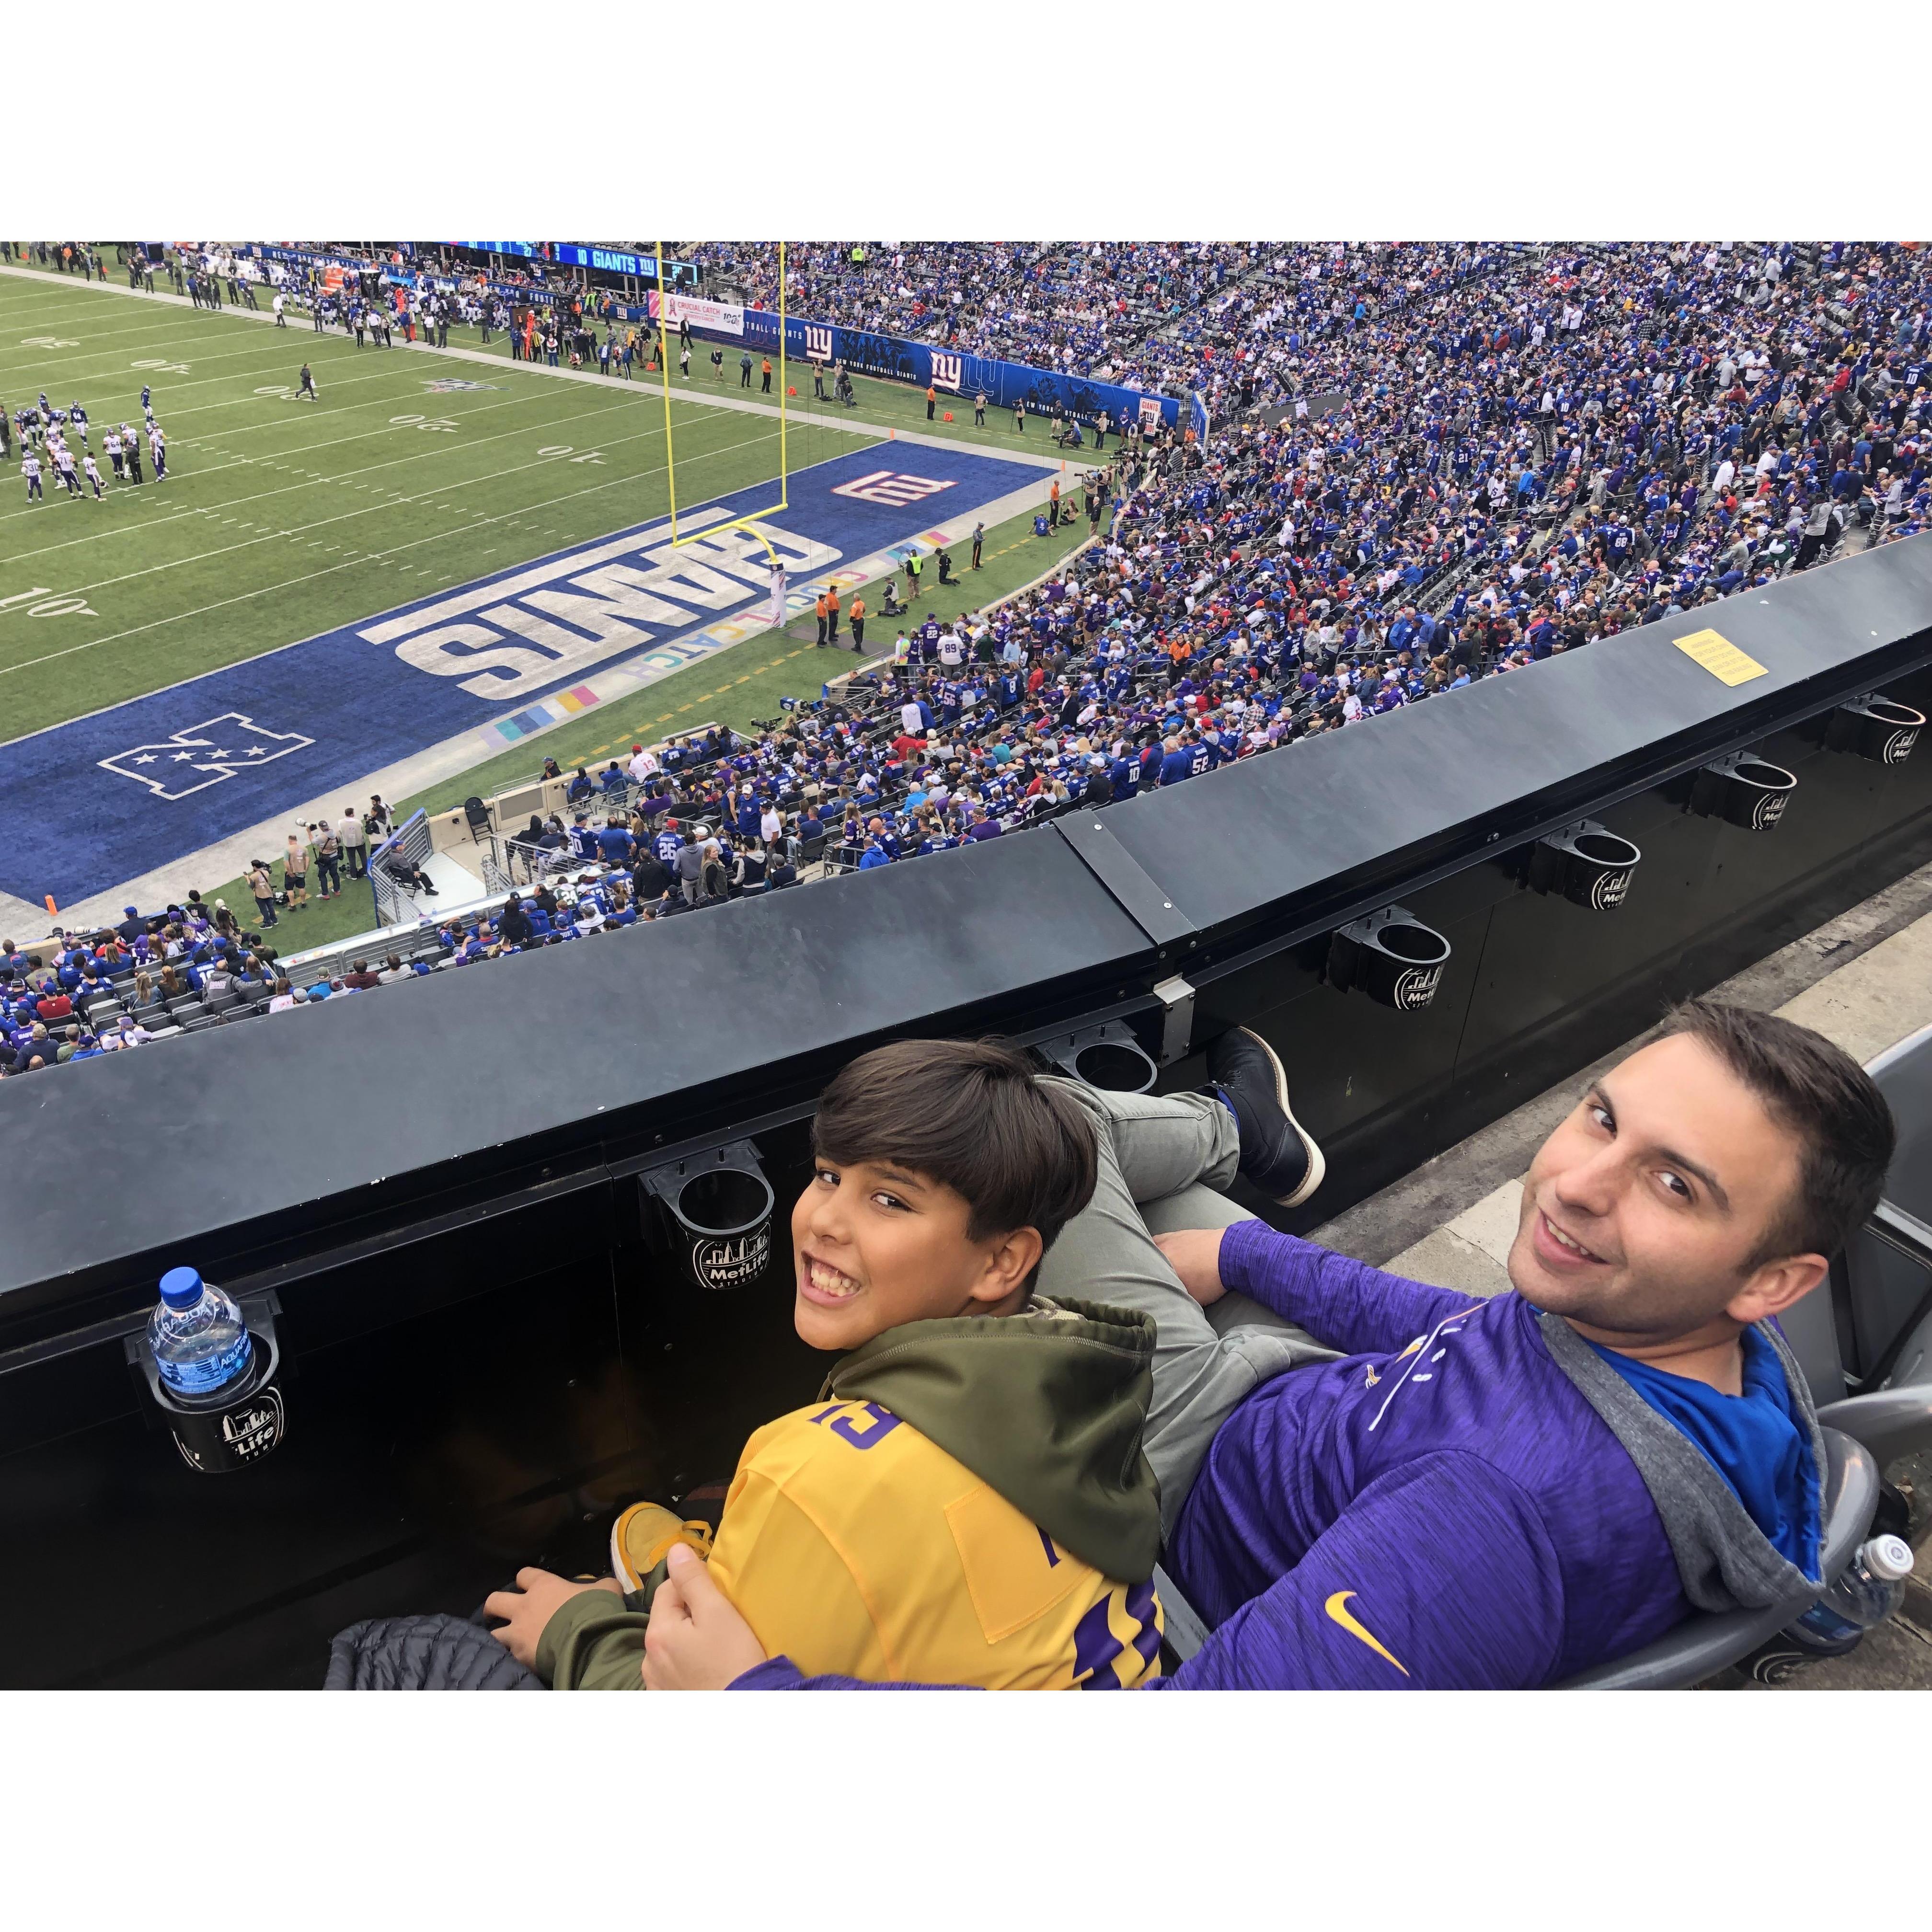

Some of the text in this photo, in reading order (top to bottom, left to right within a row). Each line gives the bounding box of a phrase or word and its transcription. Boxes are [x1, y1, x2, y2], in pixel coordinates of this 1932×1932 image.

[577, 248, 587, 265] 10
[592, 250, 636, 274] GIANTS
[678, 301, 721, 316] CRUCIAL CATCH
[743, 321, 769, 334] TBALL
[805, 325, 832, 361] ny
[849, 360, 864, 368] YORK
[866, 364, 894, 376] FOOTBALL
[896, 370, 917, 380] GIANTS
[931, 351, 962, 391] ny
[1906, 372, 1919, 385] 10
[1141, 400, 1159, 412] GIANTS
[1560, 402, 1569, 413] 10
[1065, 409, 1089, 421] OTBALL
[388, 414, 461, 433] 20
[1145, 423, 1155, 434] RIDE
[537, 445, 608, 464] 10
[1458, 452, 1468, 463] 21
[28, 463, 39, 472] 30
[1232, 523, 1243, 534] 30
[1614, 537, 1628, 548] 88
[391, 514, 844, 701] GIANTS
[926, 629, 938, 639] 22
[621, 625, 747, 680] CATCH
[945, 644, 956, 654] 89
[1702, 646, 1718, 655] YOUR
[1702, 654, 1720, 664] SAFETY
[1712, 662, 1725, 671] LEAN
[1735, 663, 1753, 673] RAILING
[1009, 680, 1016, 694] 8
[943, 692, 956, 706] 56
[1128, 766, 1140, 783] 10
[658, 842, 677, 860] 26
[561, 890, 579, 905] 24
[208, 980, 227, 989] GIANTS
[710, 1250, 768, 1280] MetLife
[719, 1265, 764, 1288] STADIUM
